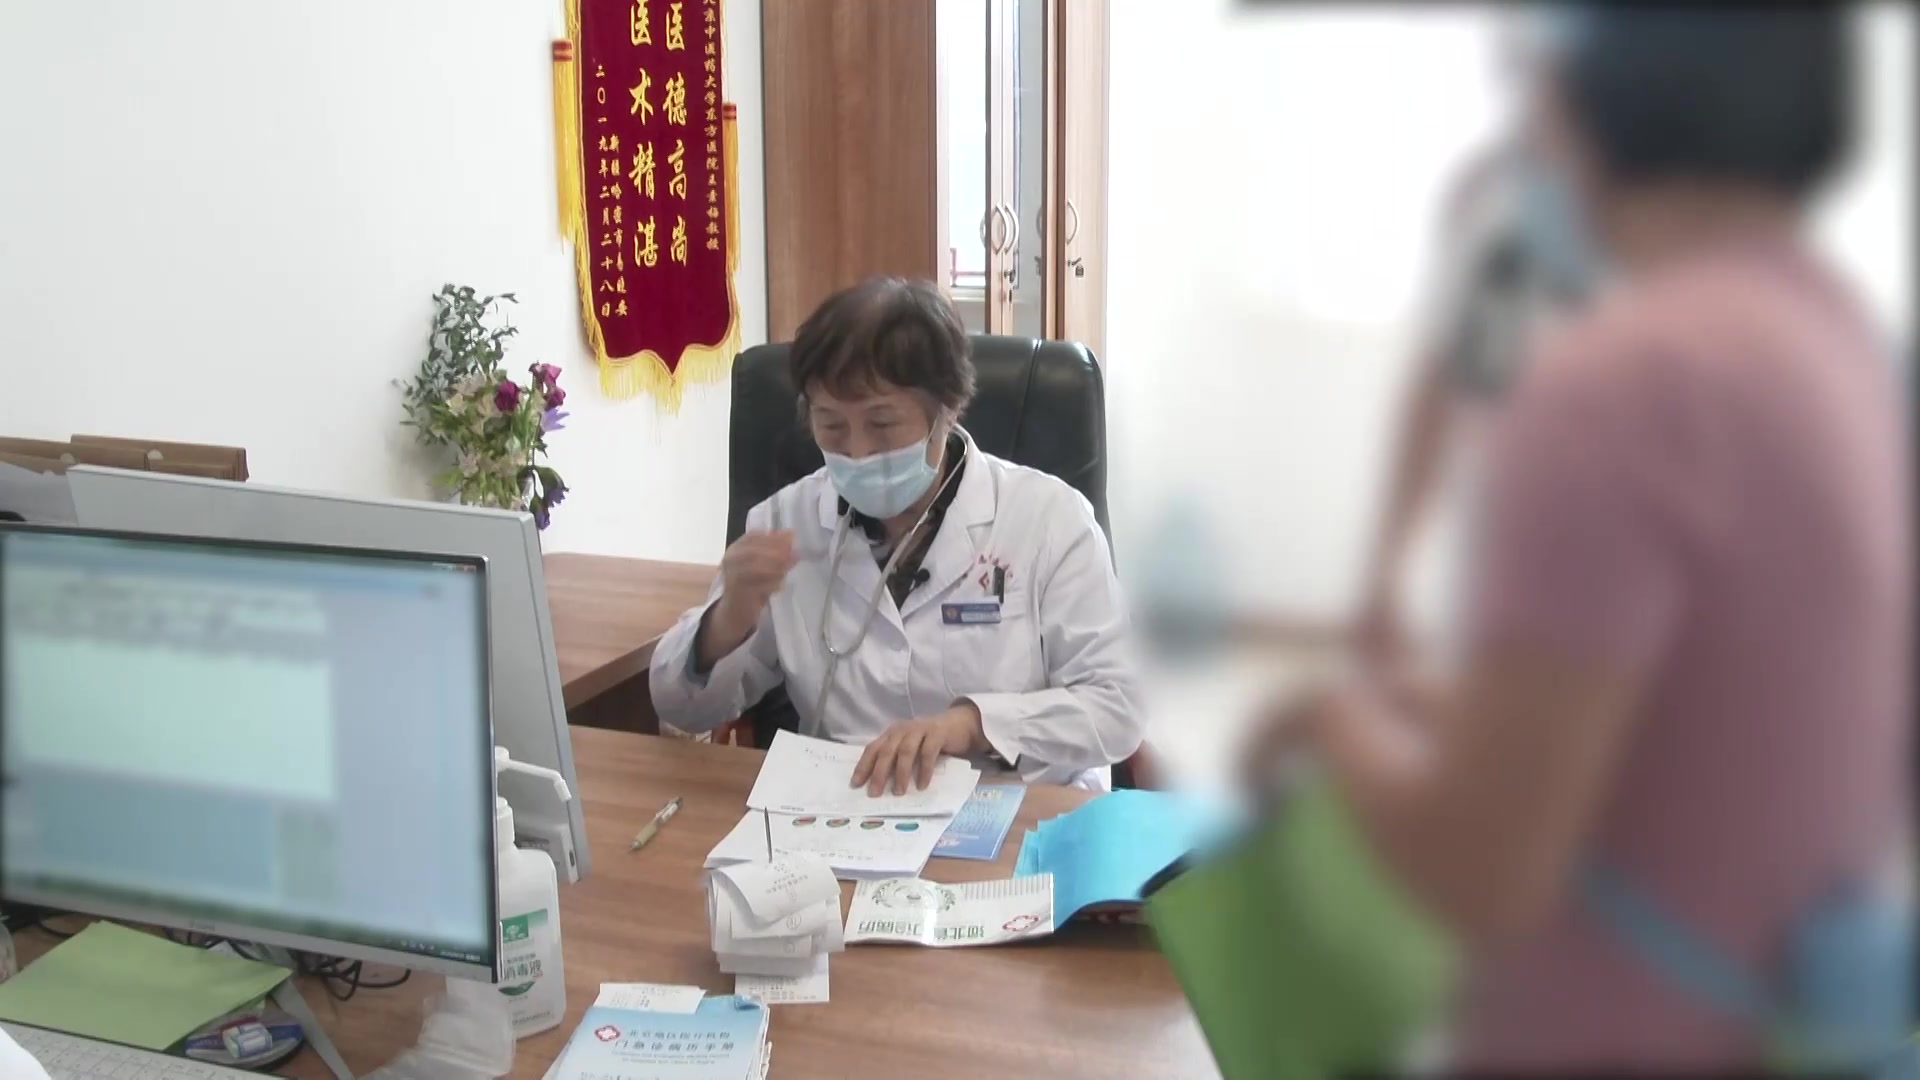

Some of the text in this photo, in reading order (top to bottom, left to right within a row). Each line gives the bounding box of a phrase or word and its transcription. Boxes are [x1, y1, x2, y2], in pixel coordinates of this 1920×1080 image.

[628, 0, 659, 268] 医术精湛
[662, 2, 688, 268] 医德高尚
[702, 0, 720, 251] 京中医药大学东方医院王素梅教授
